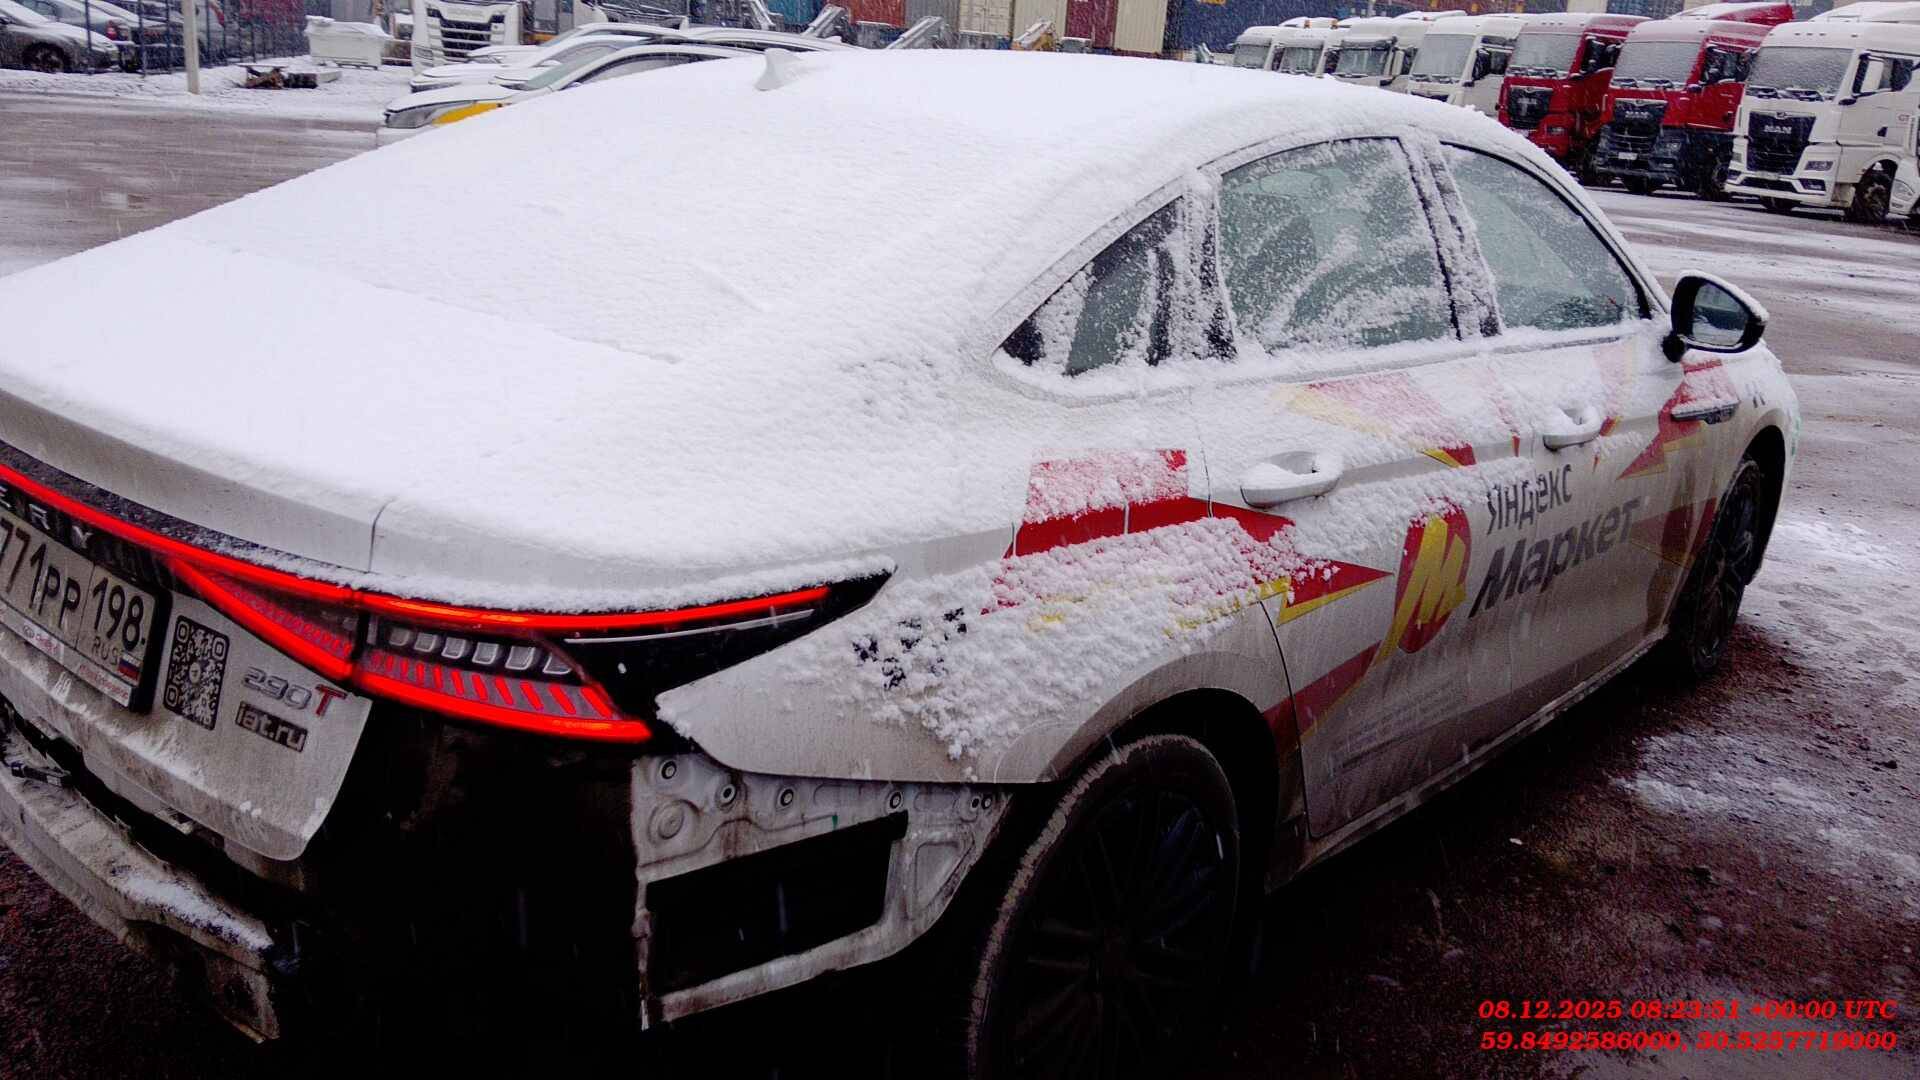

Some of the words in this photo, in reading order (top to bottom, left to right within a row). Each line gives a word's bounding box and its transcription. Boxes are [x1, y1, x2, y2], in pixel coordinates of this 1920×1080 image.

[1764, 125, 1792, 135] MAN
[1486, 463, 1573, 536] Яндекс
[1469, 496, 1642, 618] Маркет
[92, 576, 144, 651] 198
[91, 636, 119, 666] RUS
[243, 666, 347, 717] 290T
